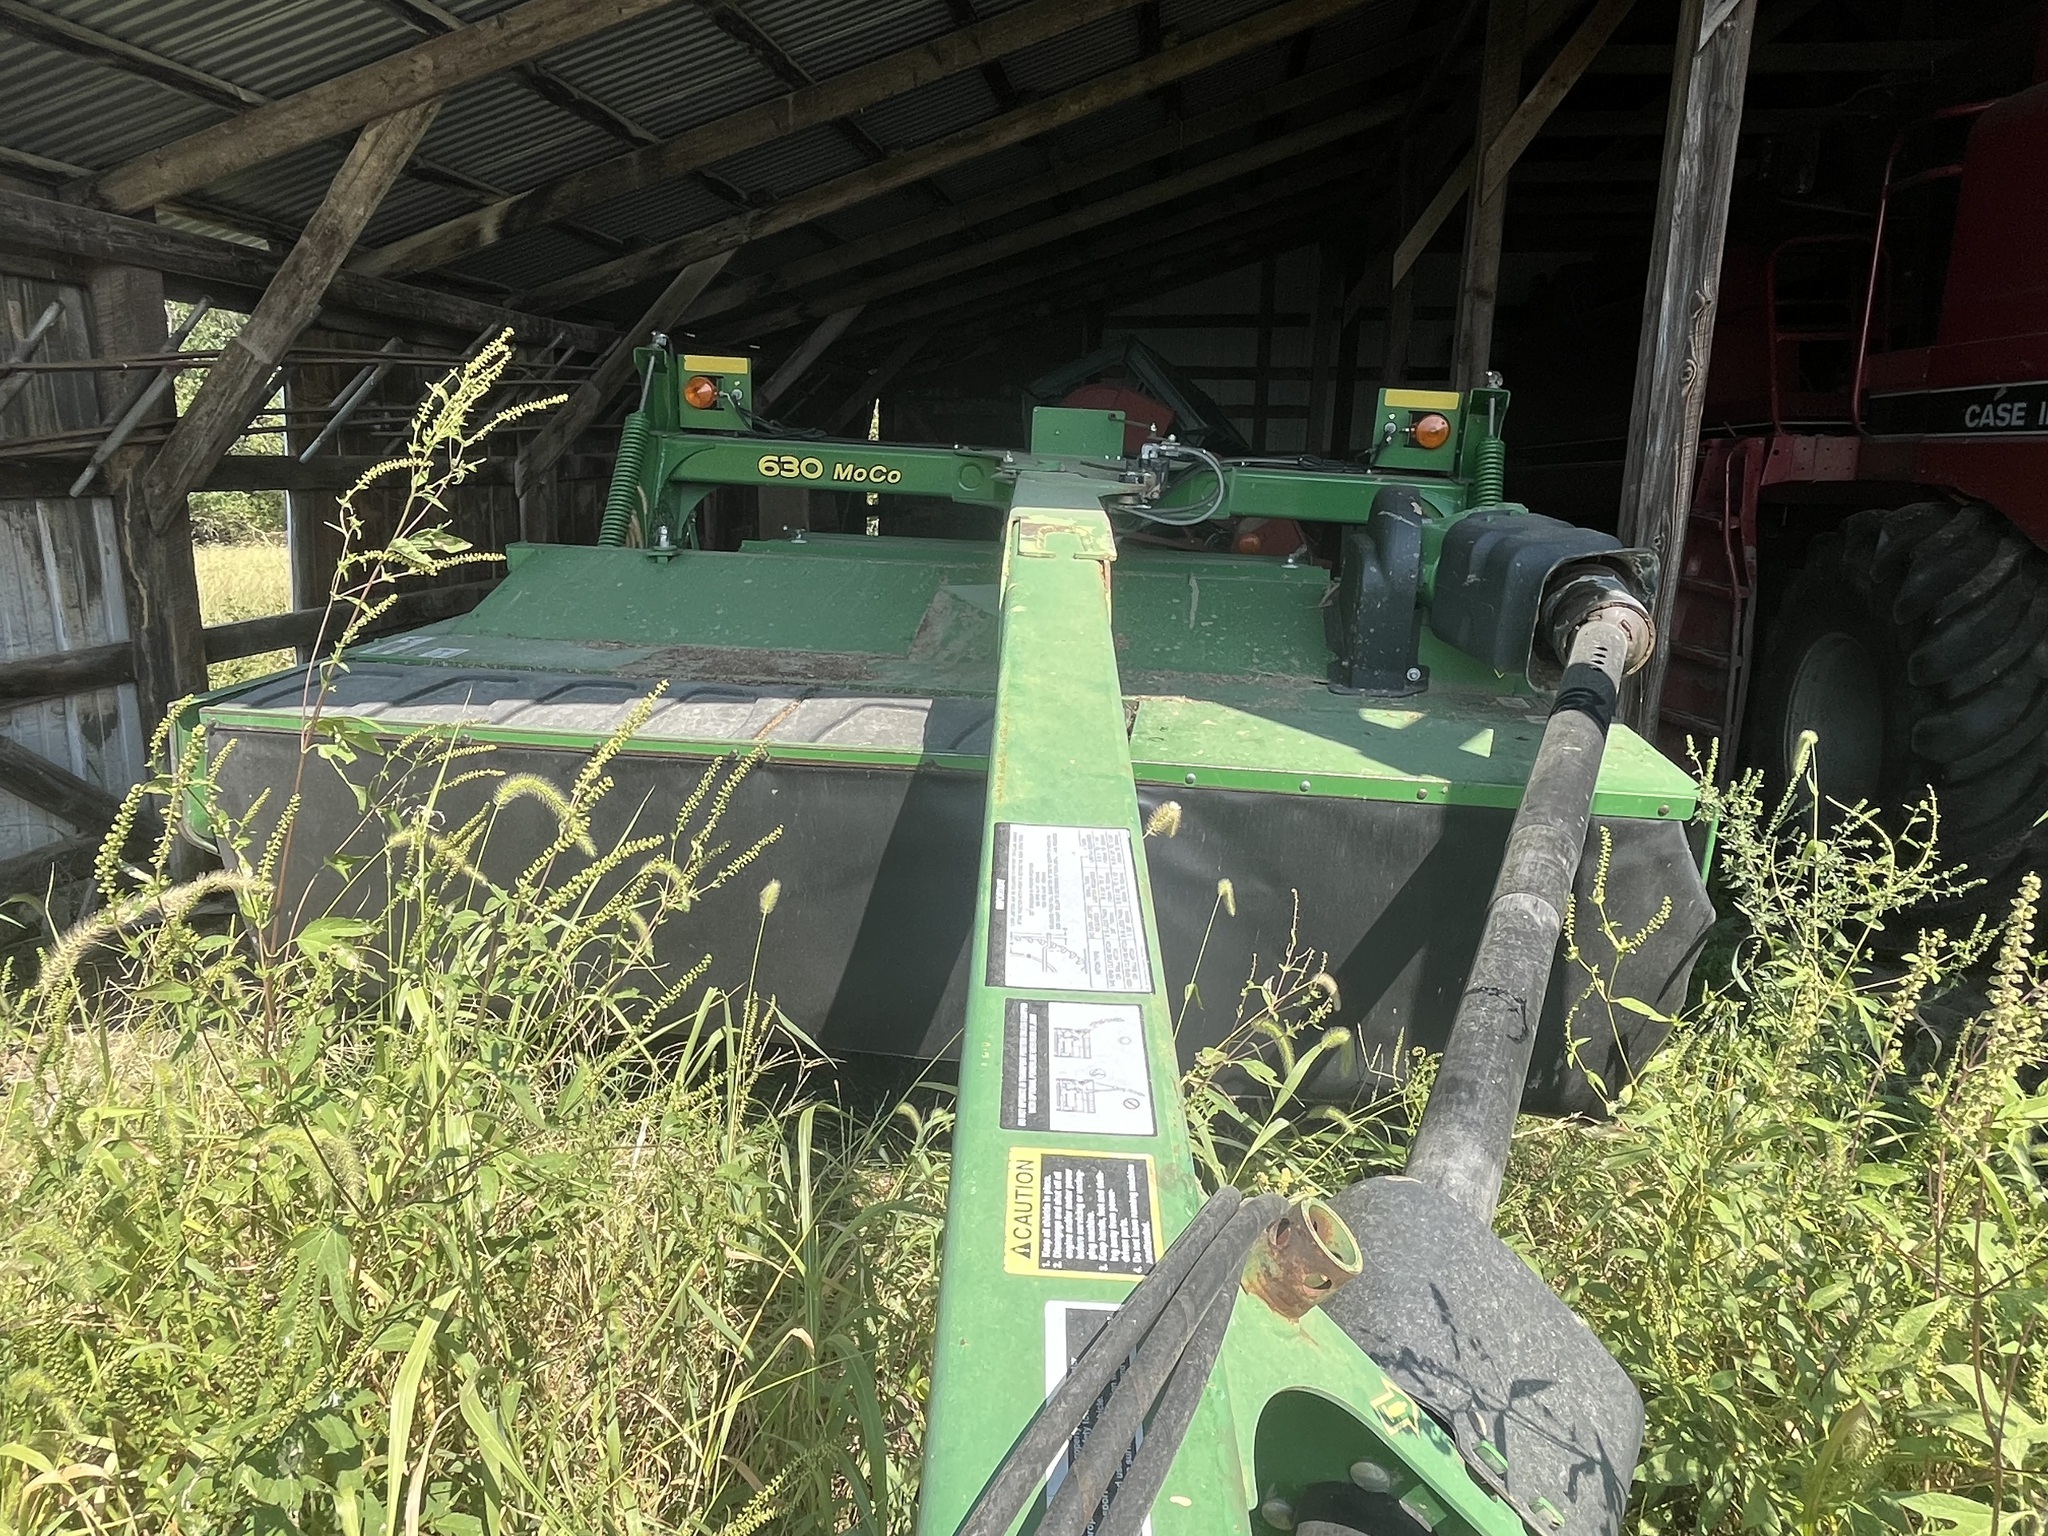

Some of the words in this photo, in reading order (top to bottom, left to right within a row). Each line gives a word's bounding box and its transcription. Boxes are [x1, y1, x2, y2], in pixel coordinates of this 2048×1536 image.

[1965, 402, 2027, 428] CASE
[758, 455, 824, 480] 630
[833, 463, 902, 484] MoCo
[1013, 1160, 1034, 1240] CAUTION
